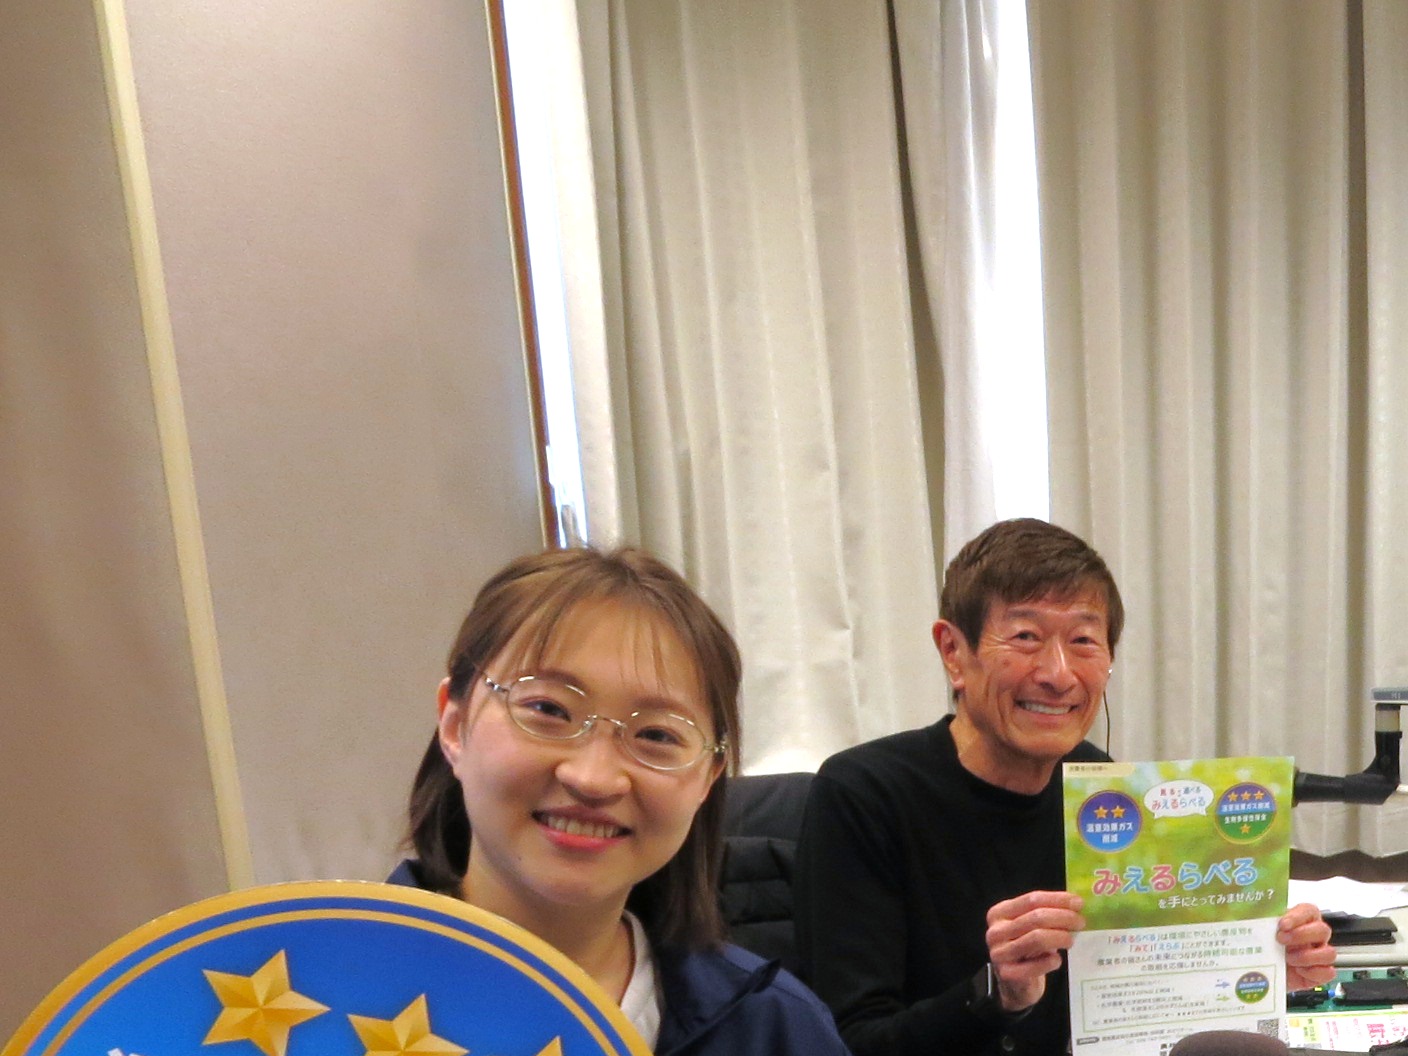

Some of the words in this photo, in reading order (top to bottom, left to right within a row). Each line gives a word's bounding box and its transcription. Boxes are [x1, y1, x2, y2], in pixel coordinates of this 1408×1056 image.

[1151, 796, 1206, 811] みえるらべる
[1092, 856, 1259, 896] みえるらべる
[1158, 888, 1275, 909] を手にとってみませんか？
